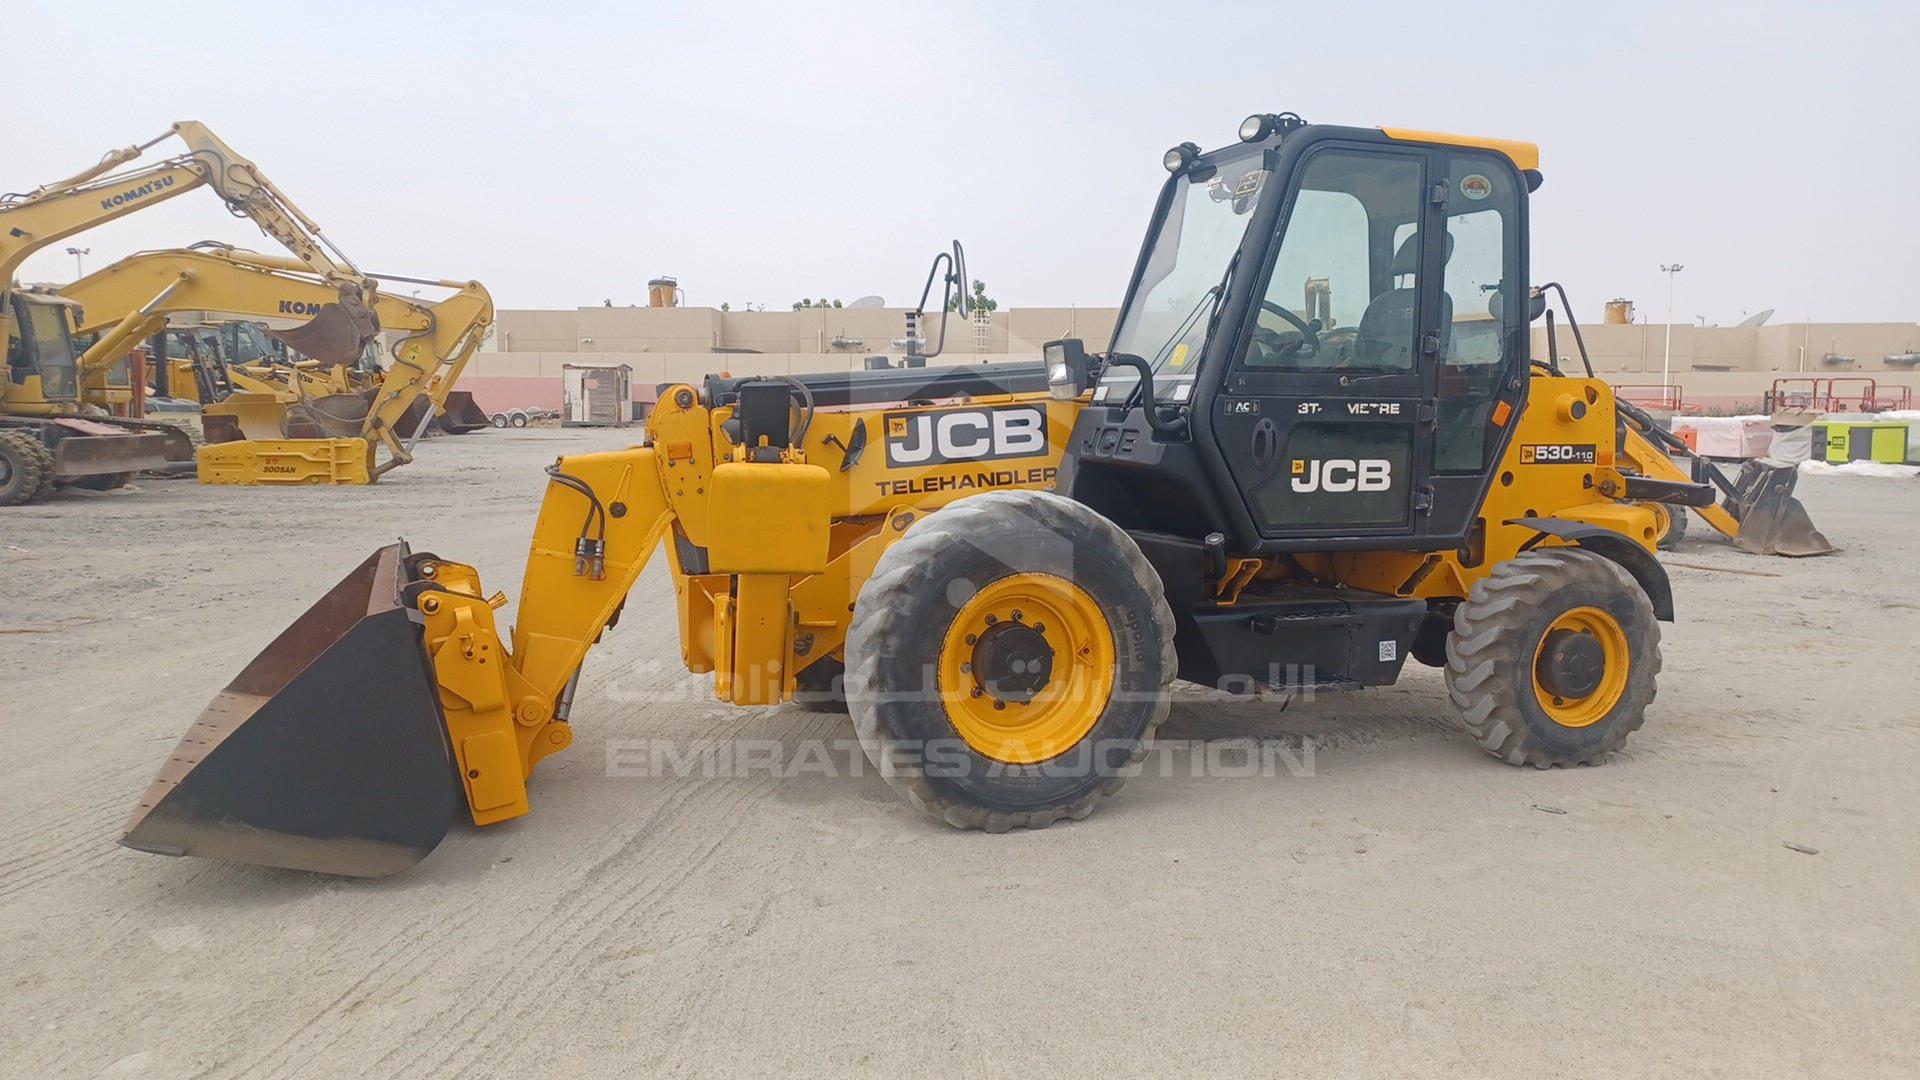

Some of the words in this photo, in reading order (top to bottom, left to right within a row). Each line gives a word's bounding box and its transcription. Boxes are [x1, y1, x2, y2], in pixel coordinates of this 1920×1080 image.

[101, 175, 174, 210] KOMATSU
[279, 300, 320, 316] KOM
[1235, 402, 1250, 412] AC
[890, 408, 1045, 463] JCB
[875, 467, 1058, 496] TELEHANDLER
[1291, 459, 1391, 492] JCB
